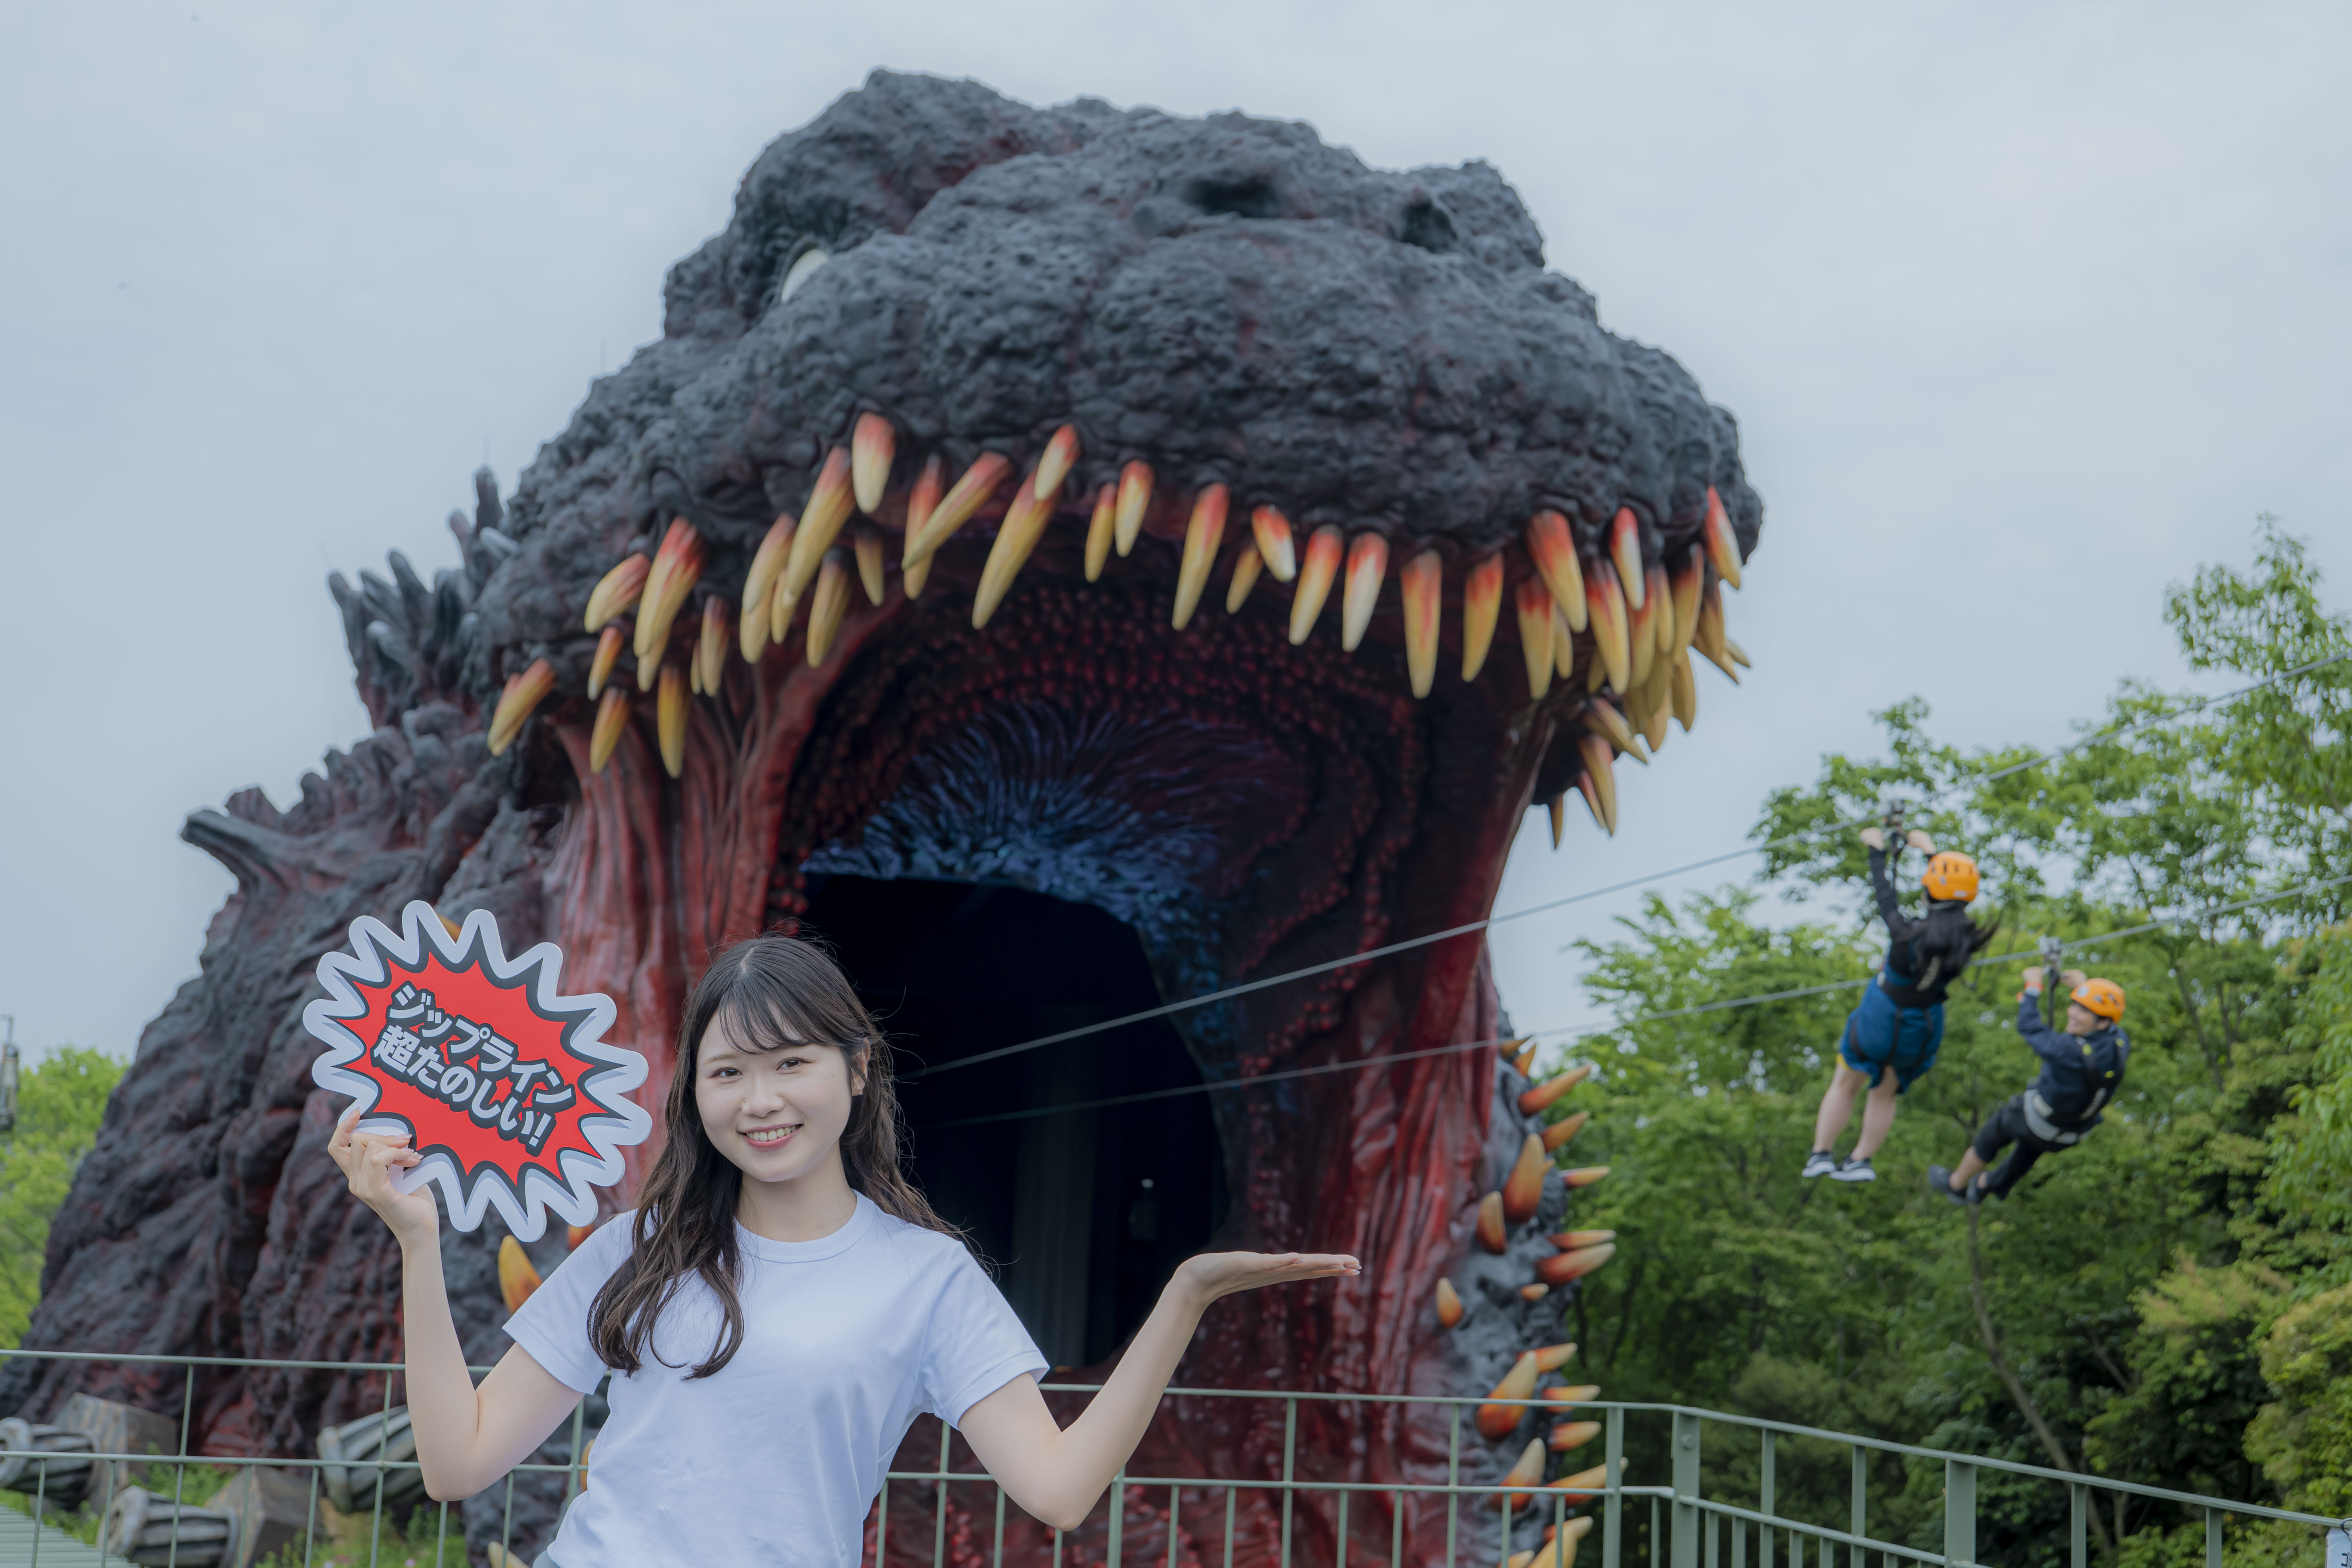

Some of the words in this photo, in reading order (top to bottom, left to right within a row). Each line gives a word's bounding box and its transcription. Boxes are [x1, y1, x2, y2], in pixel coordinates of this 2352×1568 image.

[389, 985, 572, 1103] ジップライン
